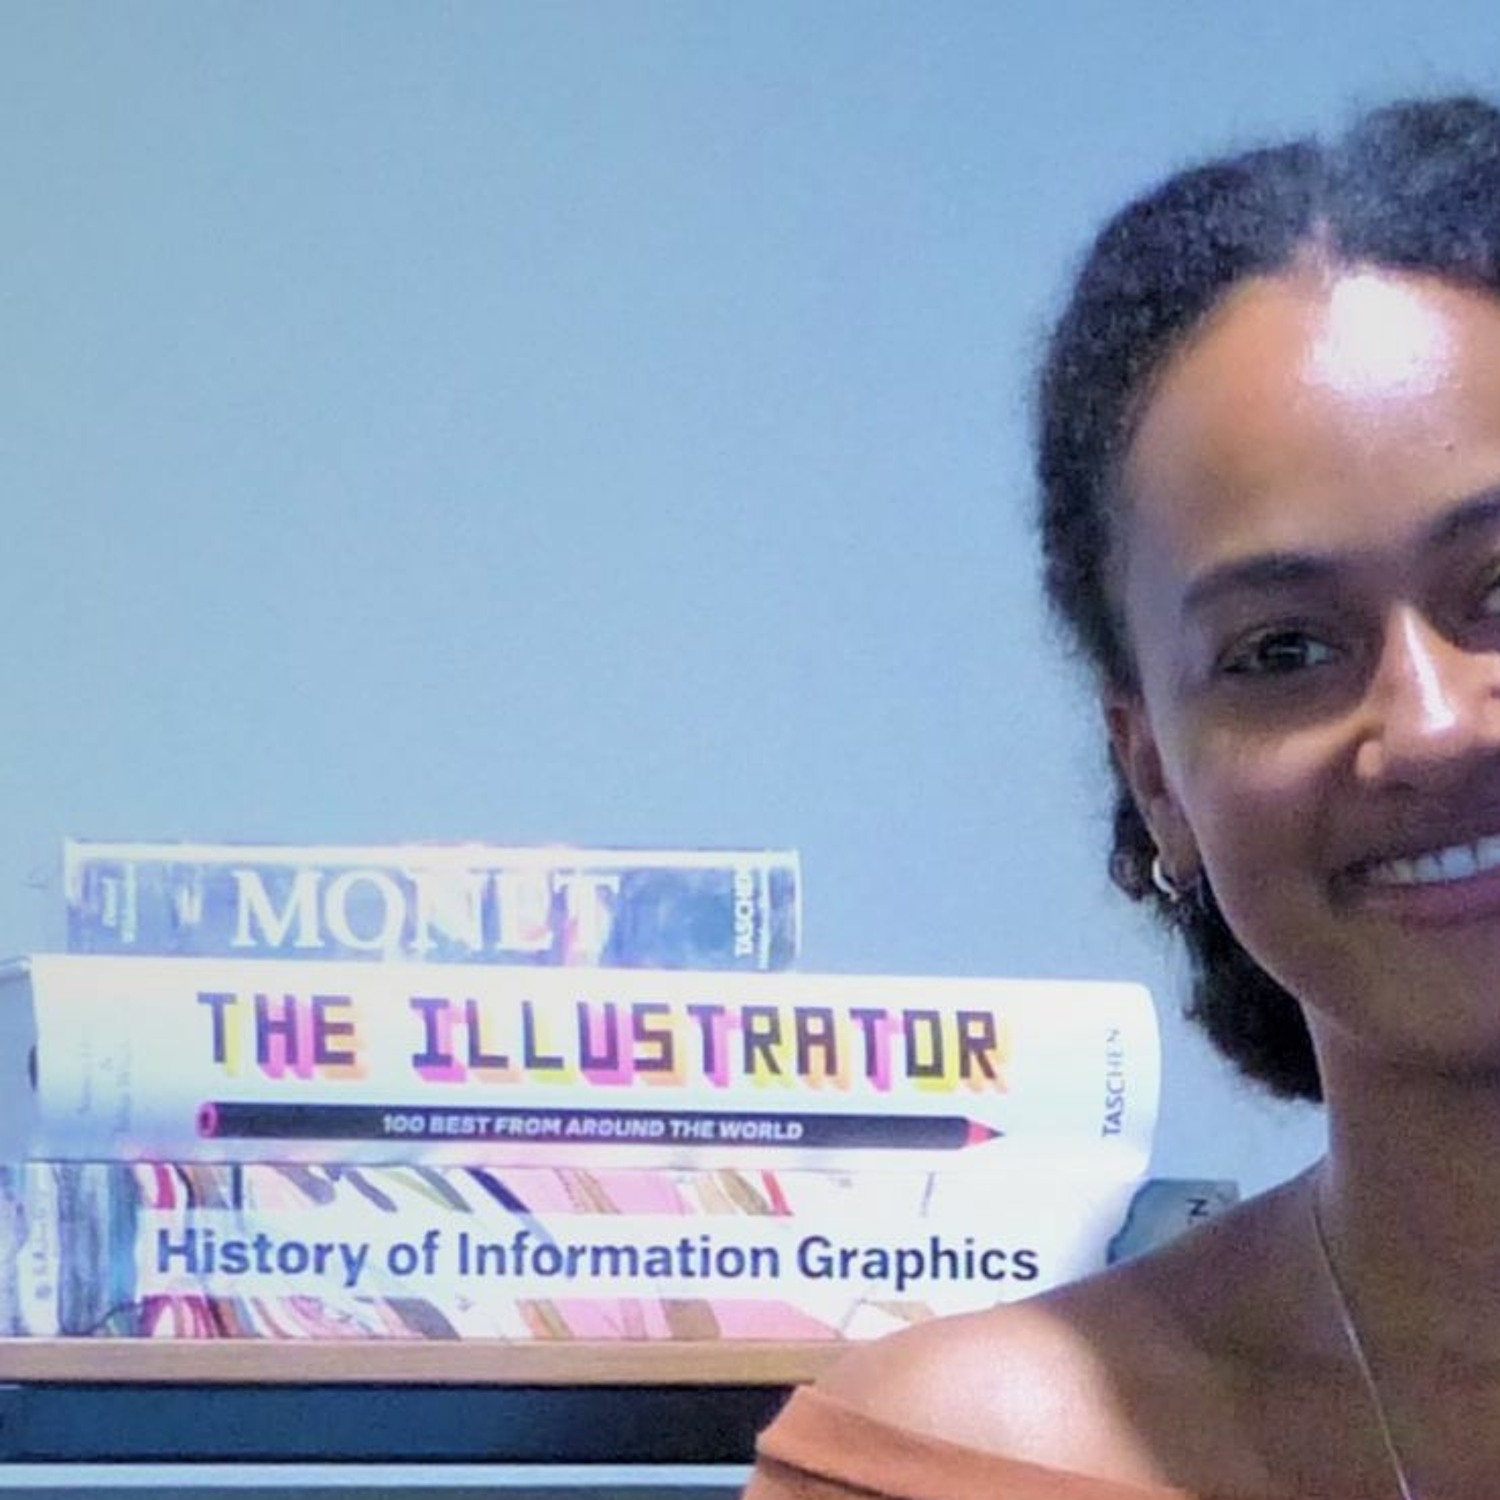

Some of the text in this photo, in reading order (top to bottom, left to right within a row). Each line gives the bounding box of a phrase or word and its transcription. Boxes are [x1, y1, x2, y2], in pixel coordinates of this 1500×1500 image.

[230, 868, 622, 964] MONET
[197, 992, 1004, 1090] THE ILLUSTRATOR
[1101, 1027, 1121, 1138] TASCHEN
[383, 1114, 804, 1141] 100 BEST FROM AROUND THE WORLD
[156, 1228, 1040, 1290] History of Information Graphics
